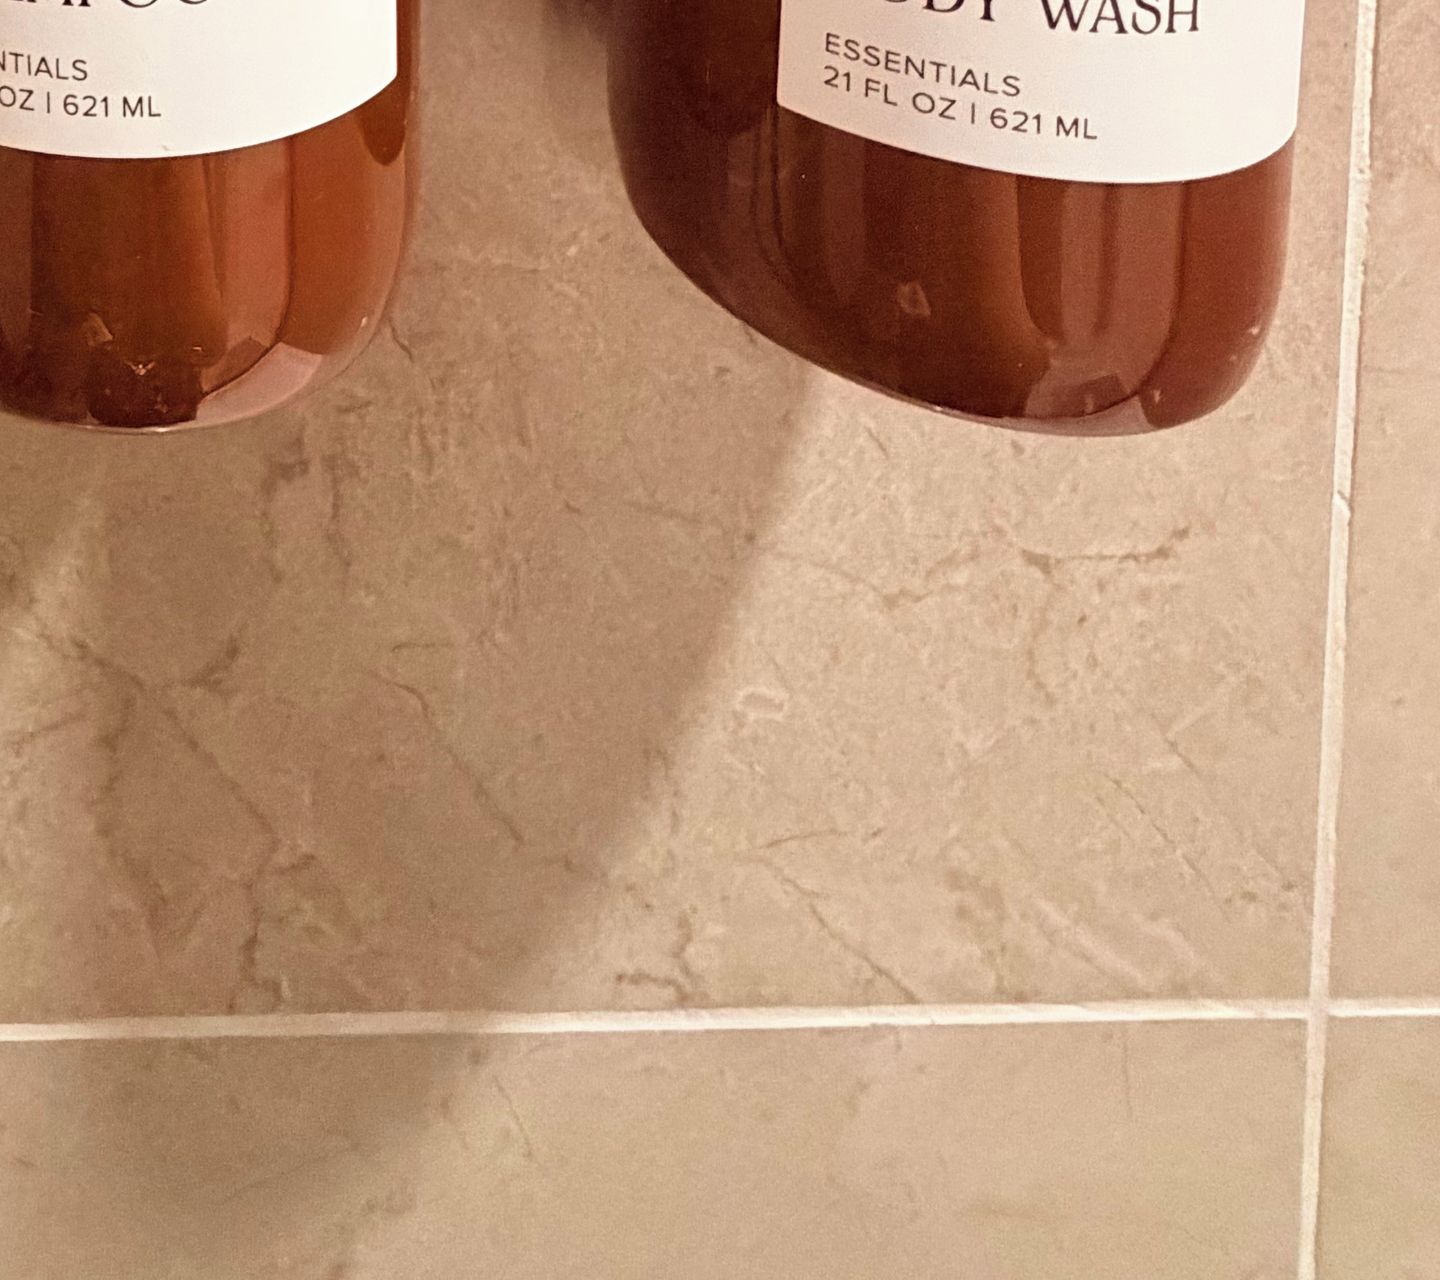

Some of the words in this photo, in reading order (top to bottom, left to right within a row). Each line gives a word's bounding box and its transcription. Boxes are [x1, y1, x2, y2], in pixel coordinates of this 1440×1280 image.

[824, 32, 1021, 97] ESSENTIALS
[63, 94, 109, 118] 621
[122, 95, 162, 118] ML
[823, 65, 851, 92] 21
[864, 78, 898, 107] FL
[911, 92, 957, 120] OZ
[990, 107, 1041, 134] 621
[1056, 115, 1098, 140] ML
